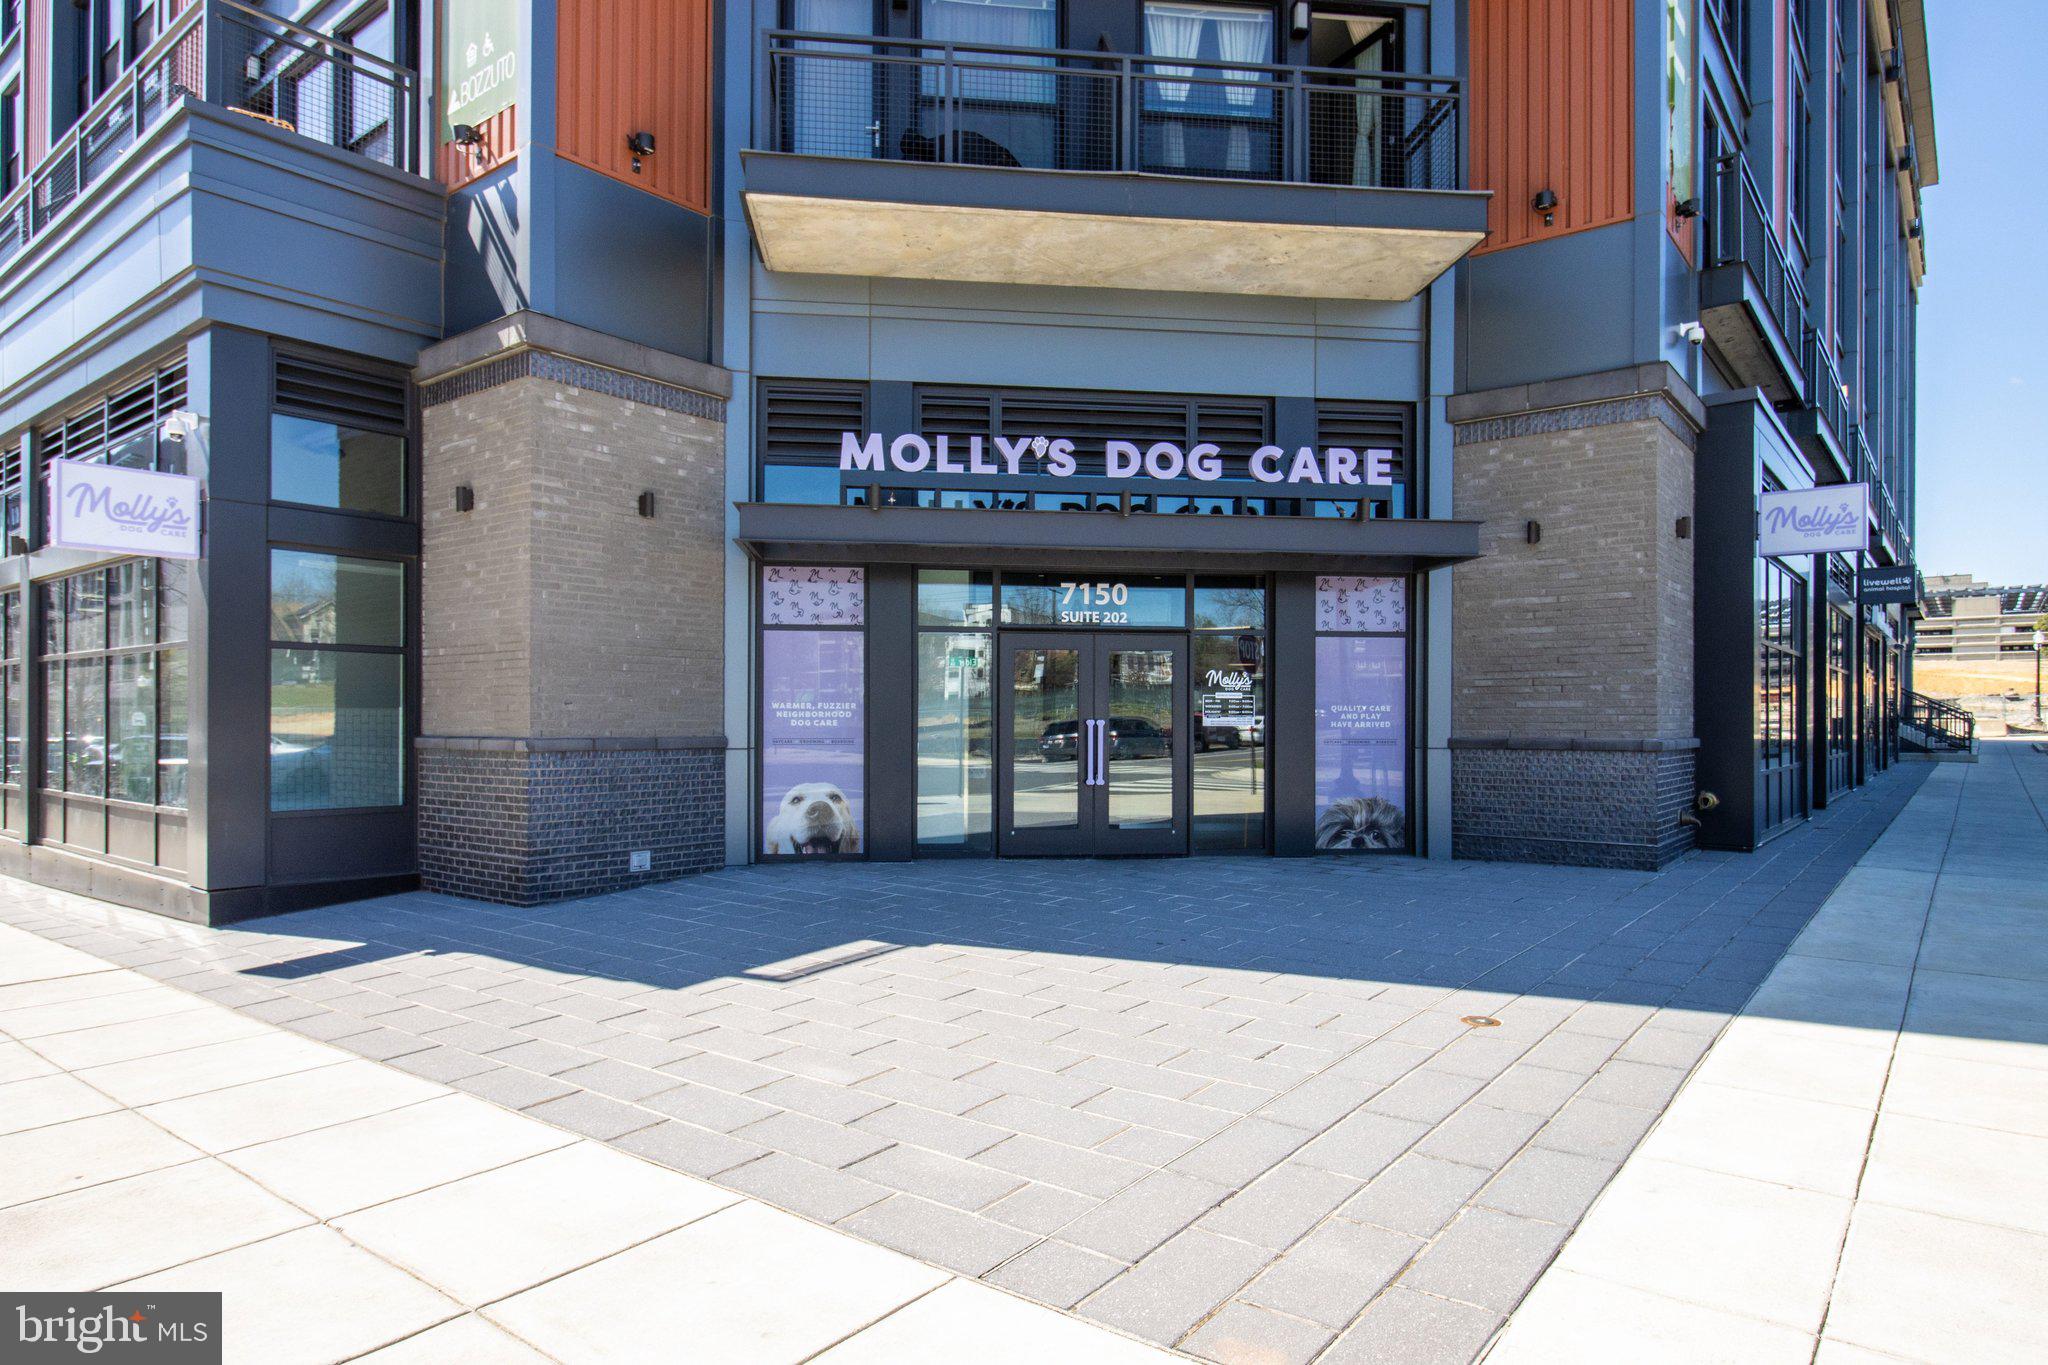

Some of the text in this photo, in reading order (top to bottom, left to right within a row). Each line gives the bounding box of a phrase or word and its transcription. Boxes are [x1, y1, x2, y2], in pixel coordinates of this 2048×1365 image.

[460, 51, 516, 107] BOZZUTO
[1105, 440, 1223, 481] DOG
[1249, 445, 1393, 486] CARE
[66, 482, 191, 533] Molly's
[1765, 503, 1859, 535] Molly's
[119, 525, 188, 538] DOG CARE
[1863, 577, 1902, 587] livewell
[1886, 584, 1911, 592] hospital
[1060, 582, 1128, 606] 7150
[1061, 611, 1128, 623] SUITE 202
[1205, 669, 1253, 690] Molly's
[771, 702, 857, 710] WARMER, FUZZIER
[790, 719, 839, 727] DOG CARE
